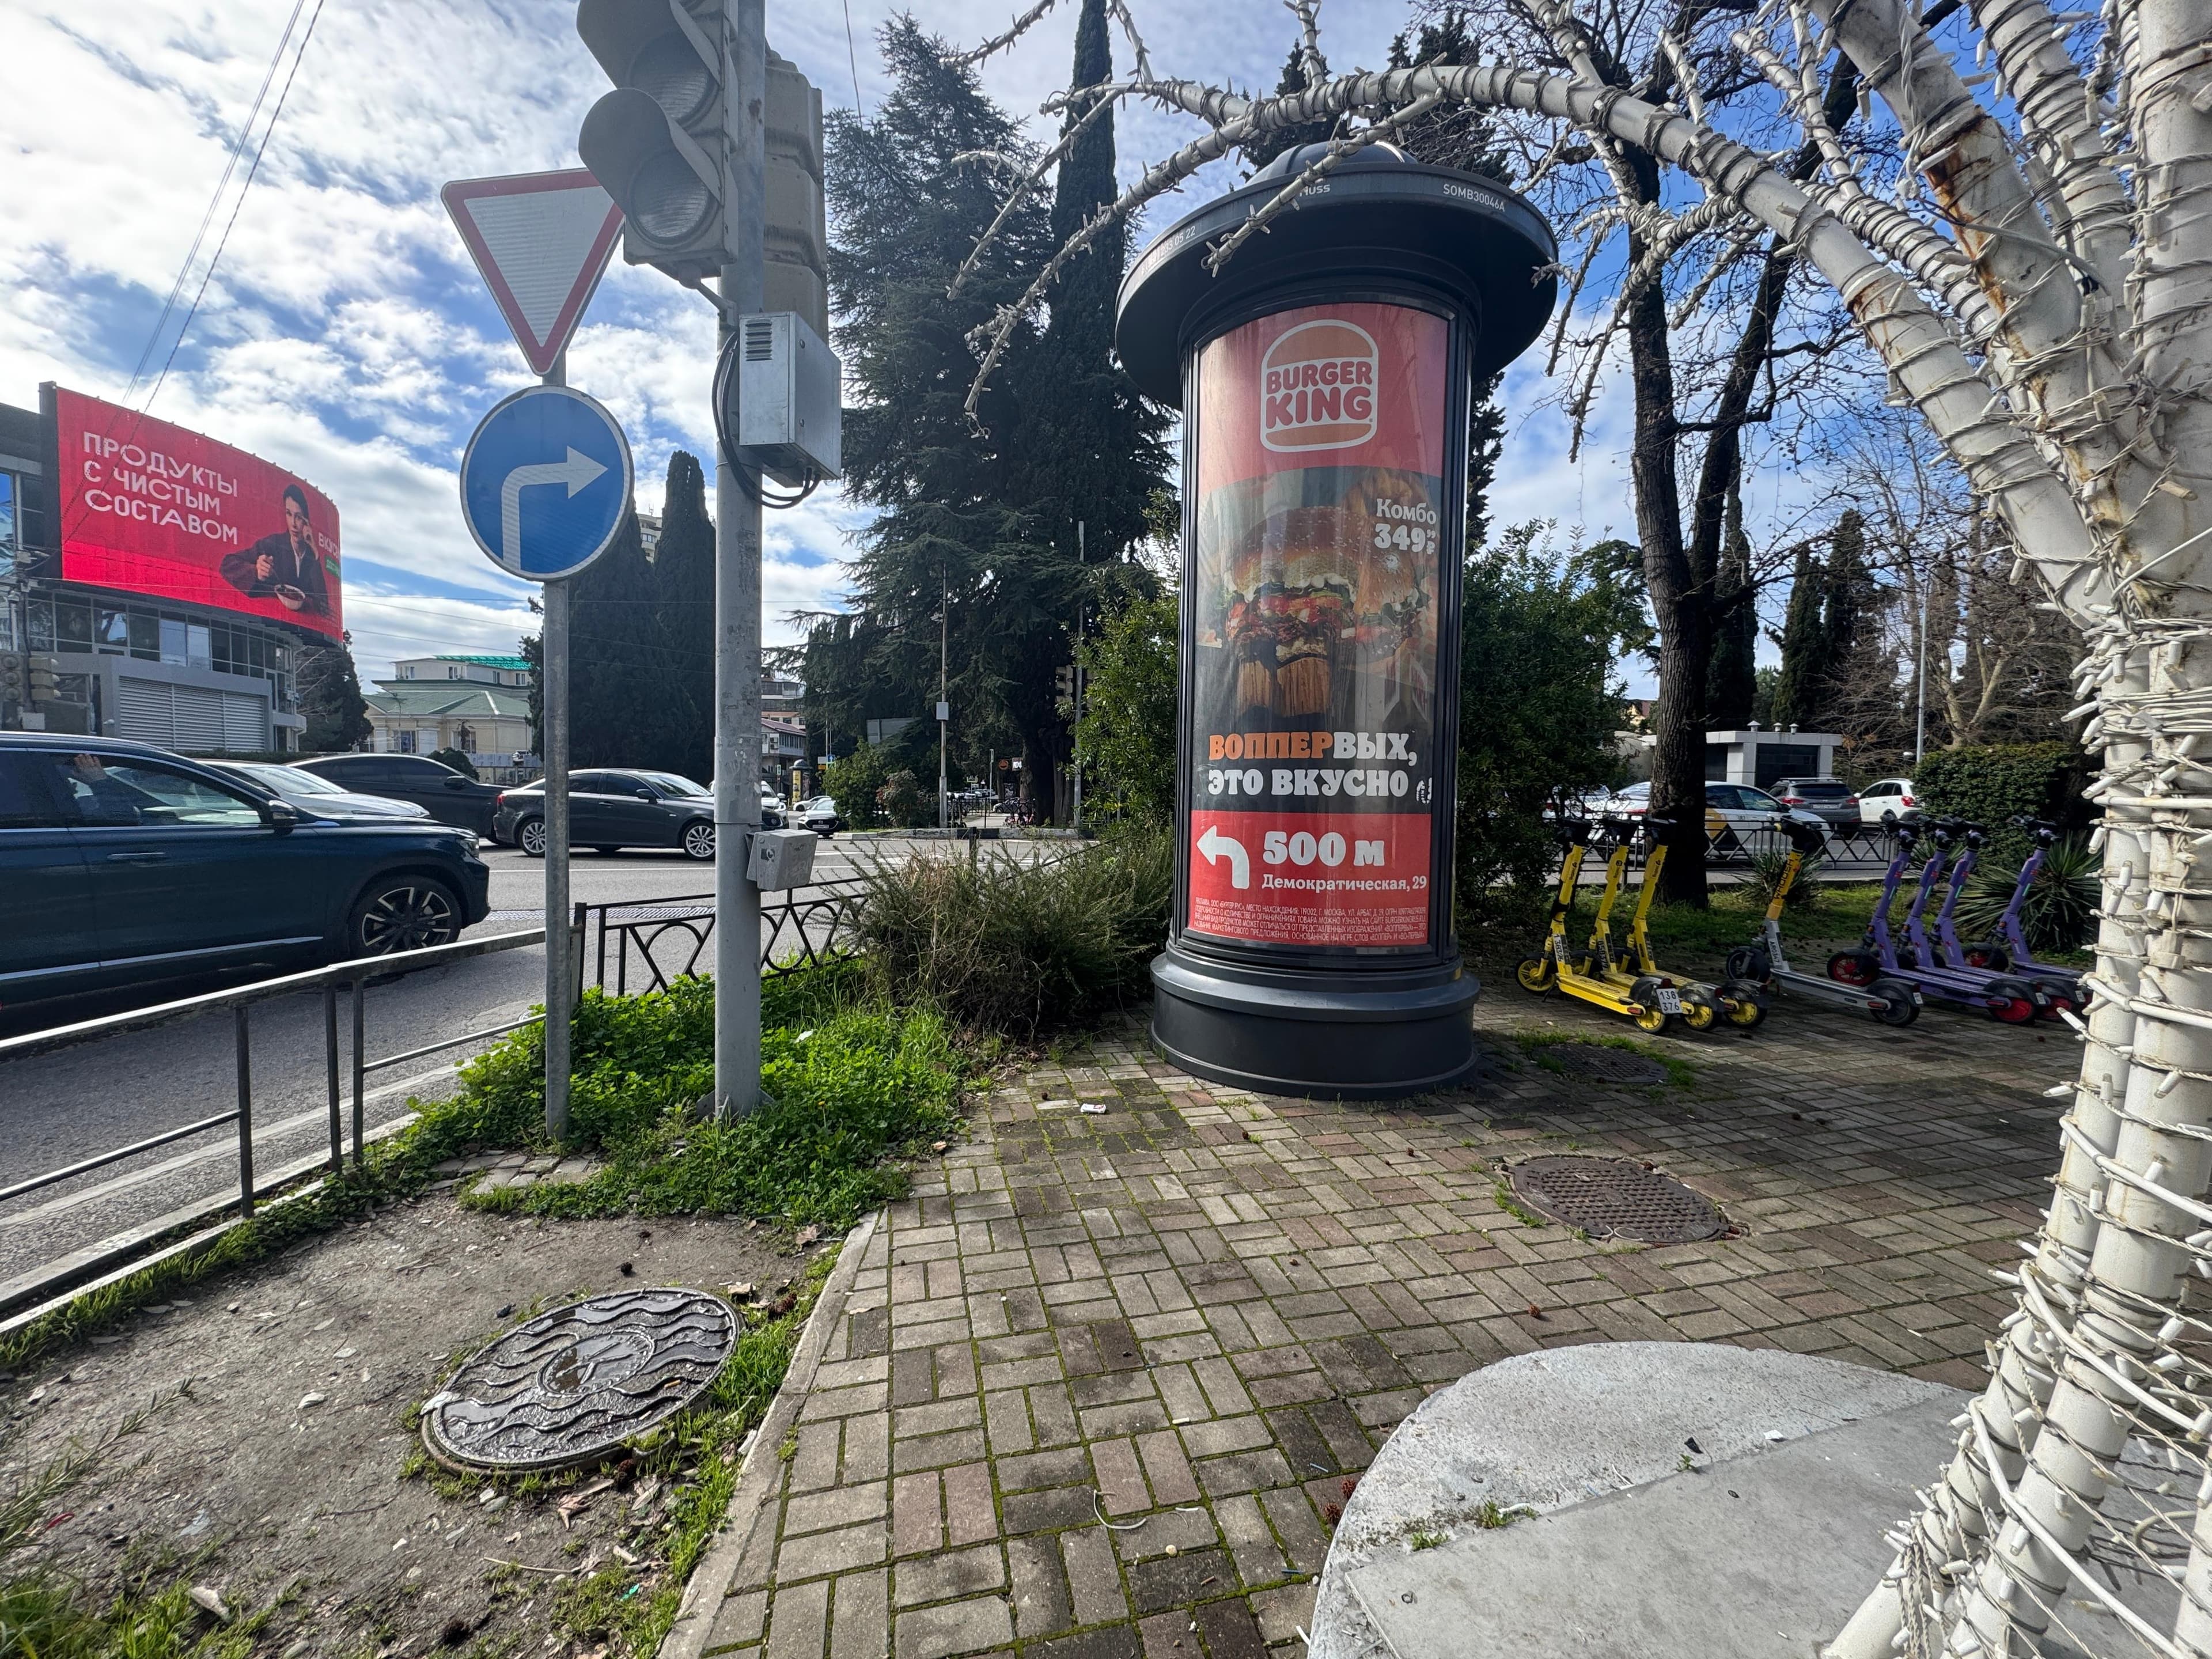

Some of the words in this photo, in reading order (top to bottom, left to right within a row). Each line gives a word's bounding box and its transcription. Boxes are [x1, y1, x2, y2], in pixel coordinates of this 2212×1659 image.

[1444, 184, 1505, 213] SOMB30046A
[1175, 232, 1184, 245] 05
[1186, 225, 1196, 239] 22
[1266, 361, 1373, 395] BURGER
[1266, 386, 1372, 429] KING
[84, 431, 237, 497] ПРОДУКТЫ
[84, 460, 101, 482] С
[113, 467, 220, 516] ЧИСТЫМ
[85, 489, 237, 545] СОСТАВОМ
[1376, 498, 1437, 525] Комбо
[1374, 523, 1426, 552] 349
[1209, 732, 1418, 766] ВОППЕРВЫХ,
[1208, 768, 1263, 796] ЭТО
[1271, 769, 1409, 797] ВКУСНО
[1263, 831, 1347, 867] 500
[1354, 840, 1385, 866] м
[1262, 873, 1410, 893] Демократическая,
[1412, 875, 1427, 889] 29
[1246, 904, 1262, 912] МЕСТО
[1256, 913, 1296, 922] ОГРАНИЧЕНИЯХ
[1297, 916, 1317, 924] ТОВАРА
[1342, 916, 1361, 925] УЗНАТЬ
[1260, 921, 1291, 930] ОТЛИЧАТЬСЯ
[1291, 931, 1329, 941] ОСНОВАННОЕ
[1354, 933, 1368, 941] СЛОВ
[1660, 991, 1676, 999] 138
[1662, 1002, 1680, 1011] 376
